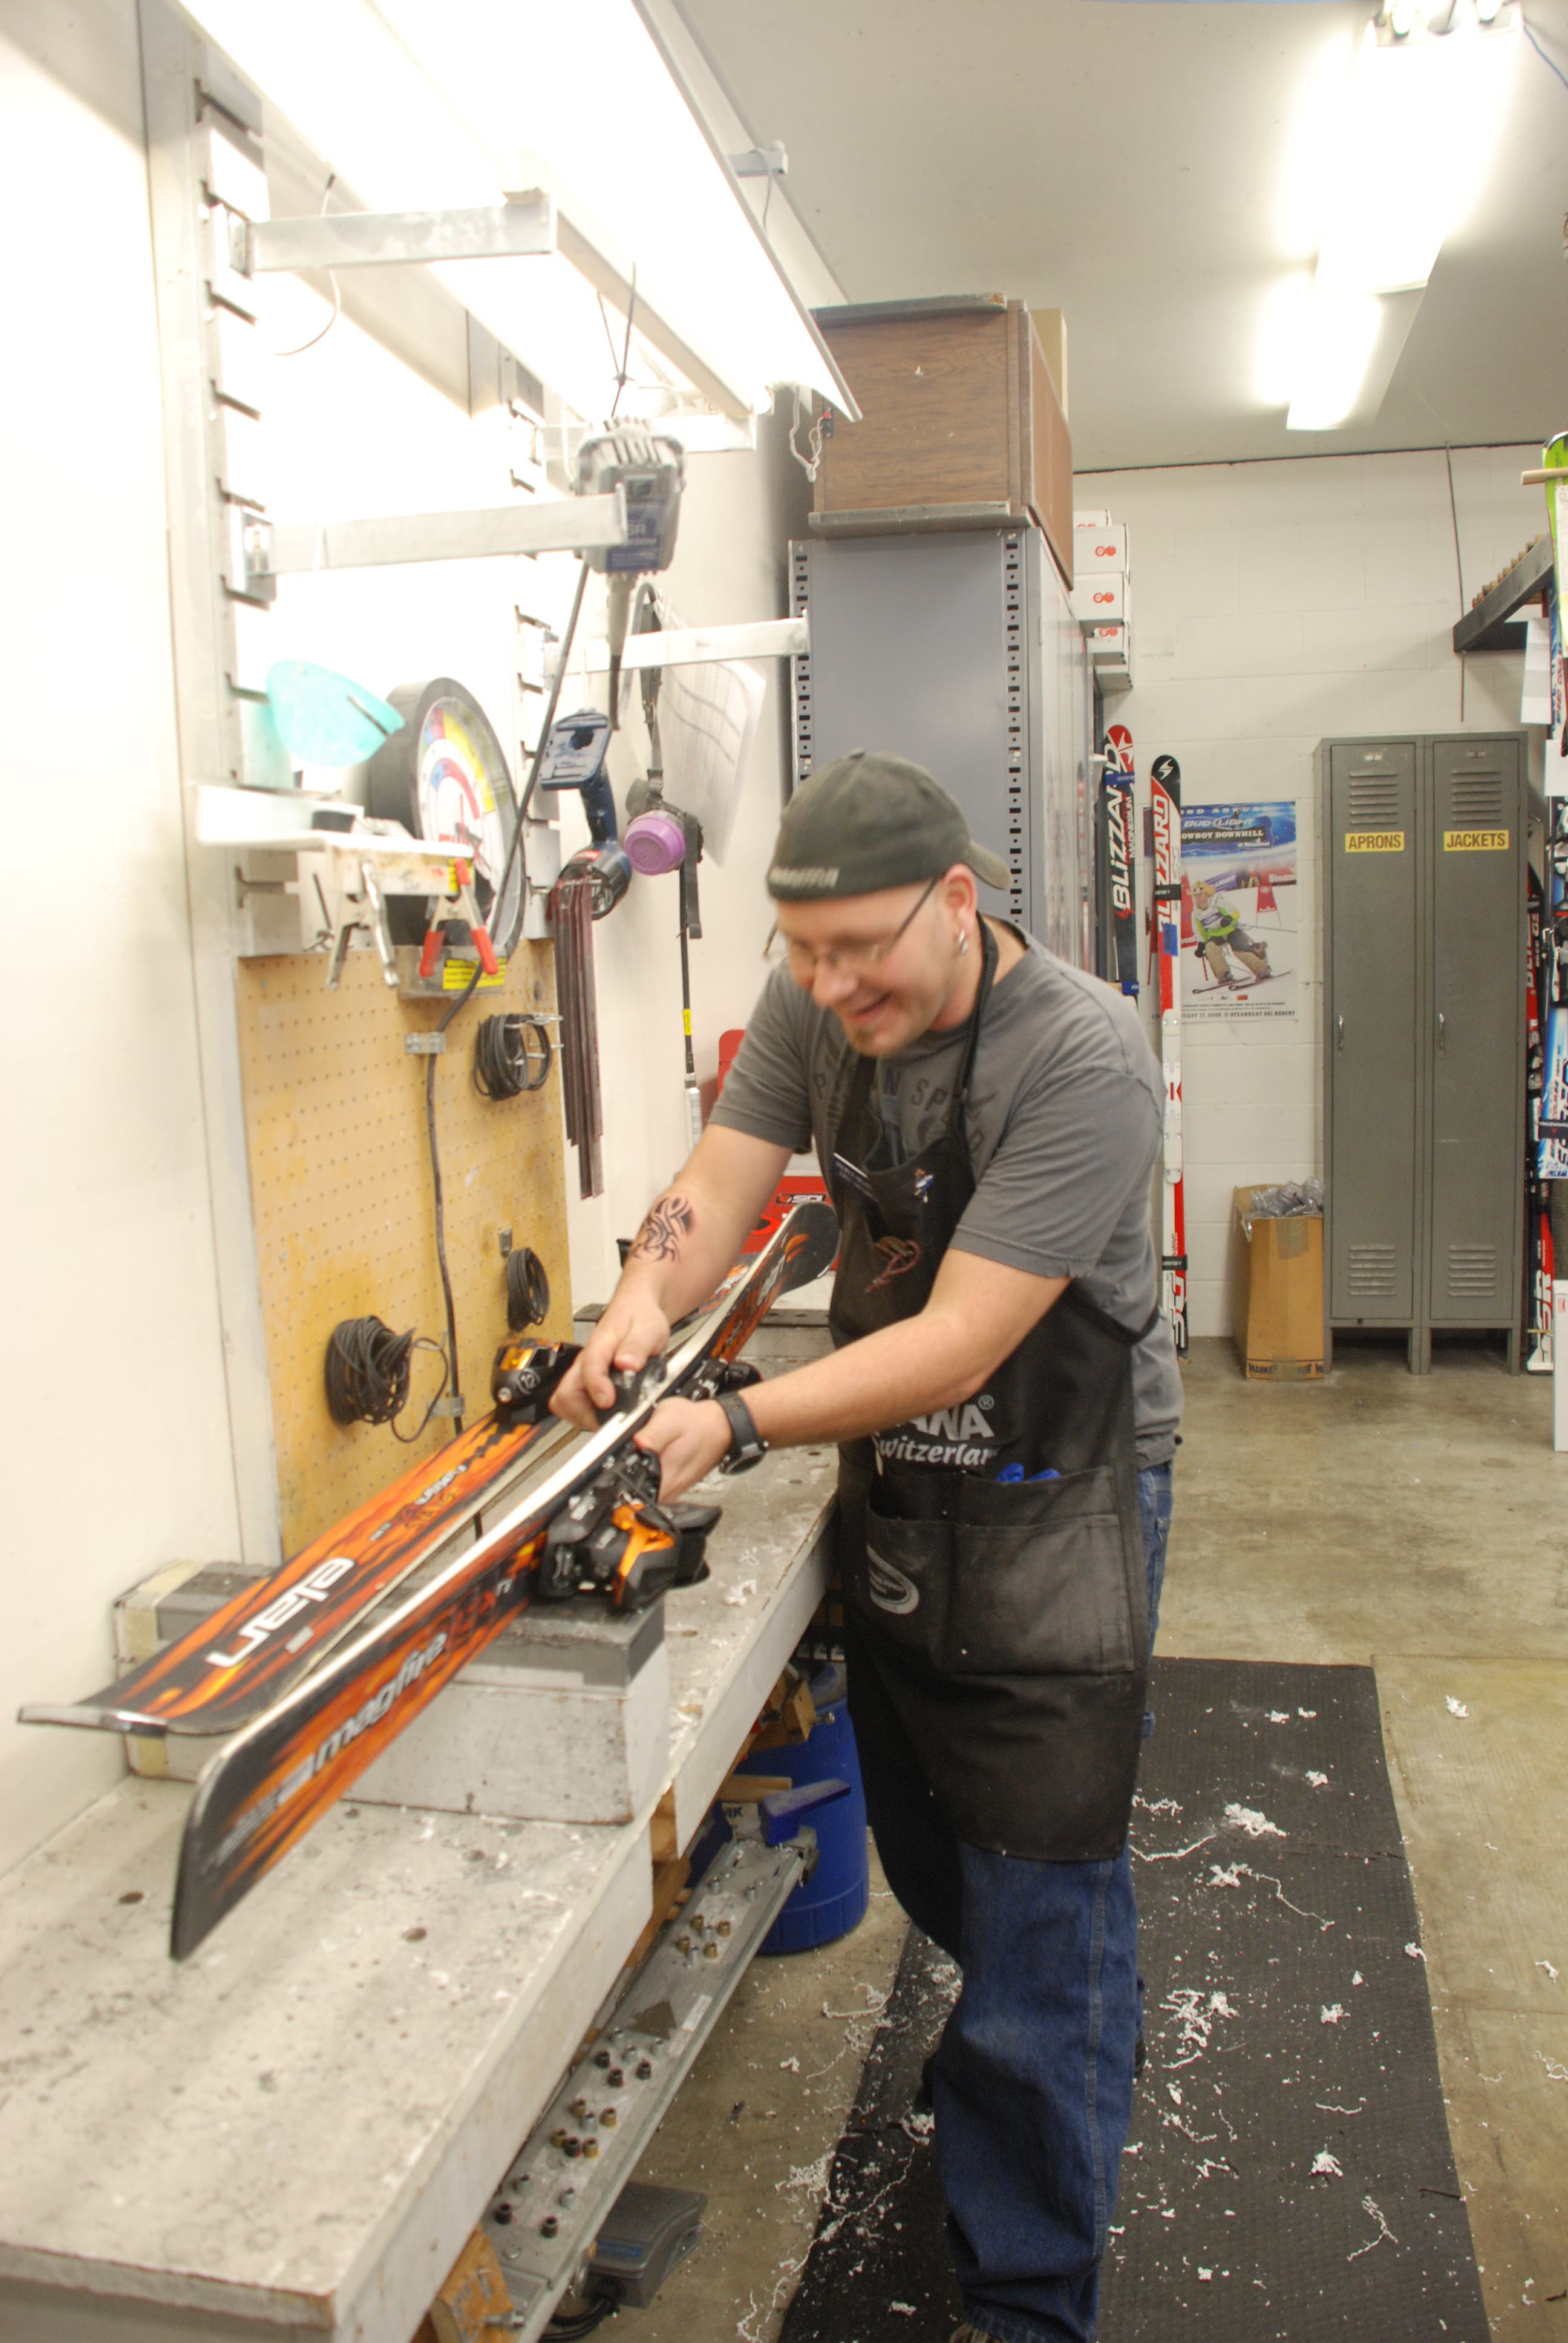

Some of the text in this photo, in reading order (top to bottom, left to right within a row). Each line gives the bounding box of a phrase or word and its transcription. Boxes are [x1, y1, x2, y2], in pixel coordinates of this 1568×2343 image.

[1105, 743, 1131, 909] BLiZZAD
[1126, 796, 1135, 858] MAGNESIUM
[1153, 795, 1171, 932] BLZZARD
[1215, 830, 1264, 838] DOWNHILL
[1348, 834, 1401, 850] APRONS
[1446, 833, 1506, 848] JACKETS
[206, 1557, 355, 1668] elan
[313, 1633, 447, 1774] magfire
